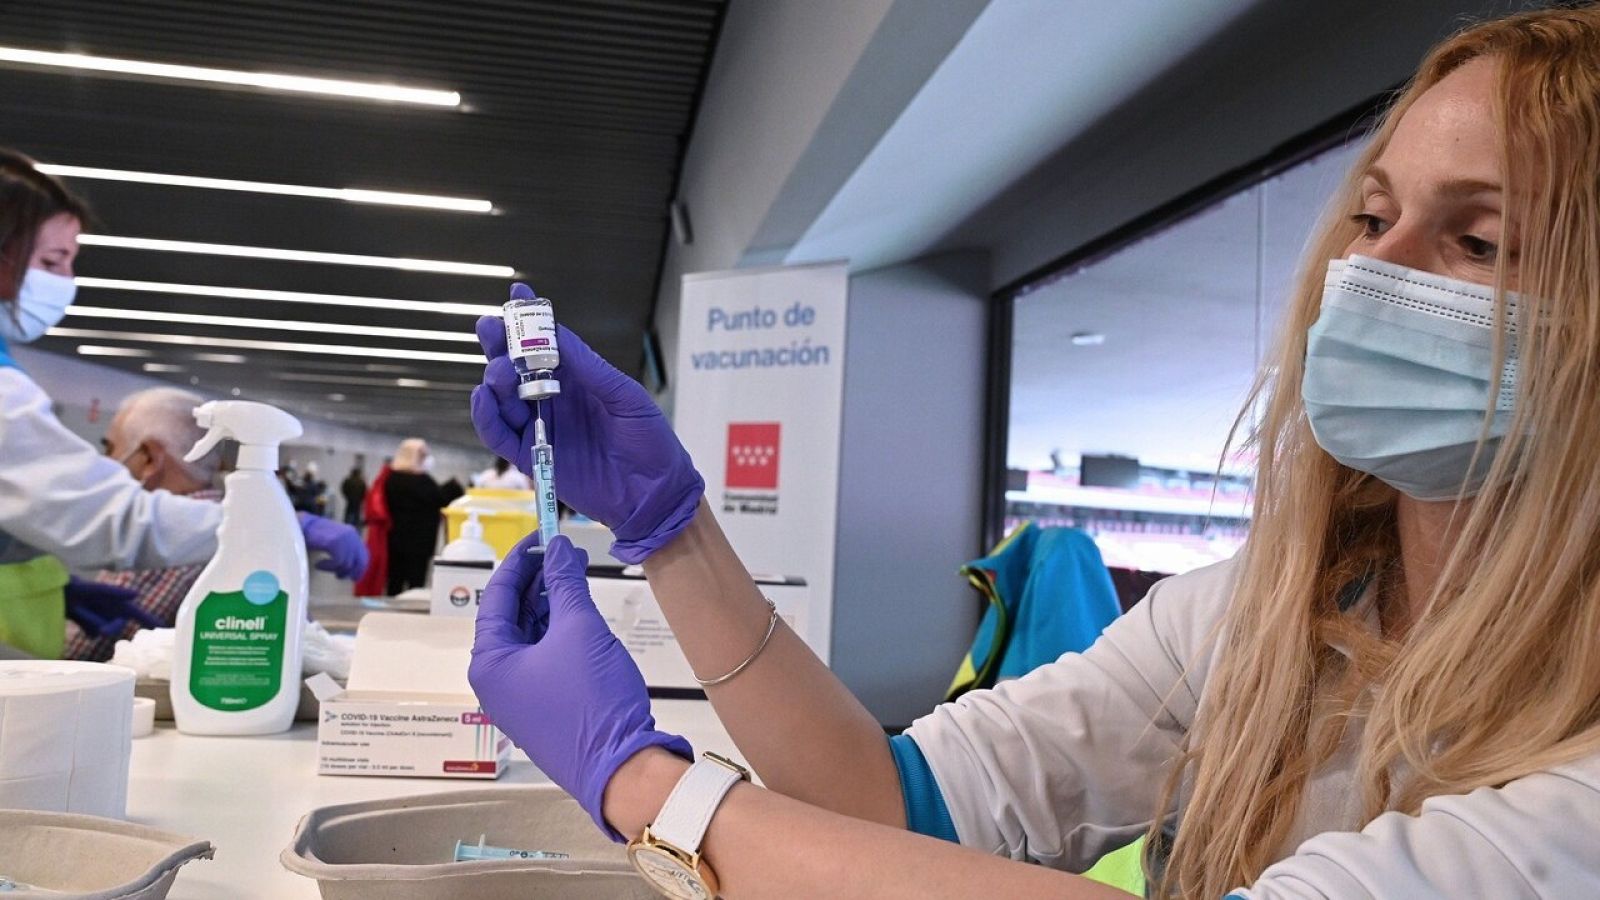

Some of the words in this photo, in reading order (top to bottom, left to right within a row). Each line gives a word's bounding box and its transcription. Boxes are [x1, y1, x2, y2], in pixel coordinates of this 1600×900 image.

[707, 305, 778, 332] Punto
[783, 301, 817, 328] de
[690, 338, 830, 370] vacunación
[214, 615, 266, 631] clinell
[199, 631, 247, 641] UNIVERSAL
[249, 632, 279, 641] SPRAY
[340, 713, 379, 721] COVID-19
[380, 713, 410, 722] Vaccine
[411, 714, 459, 723] AstraZeneca
